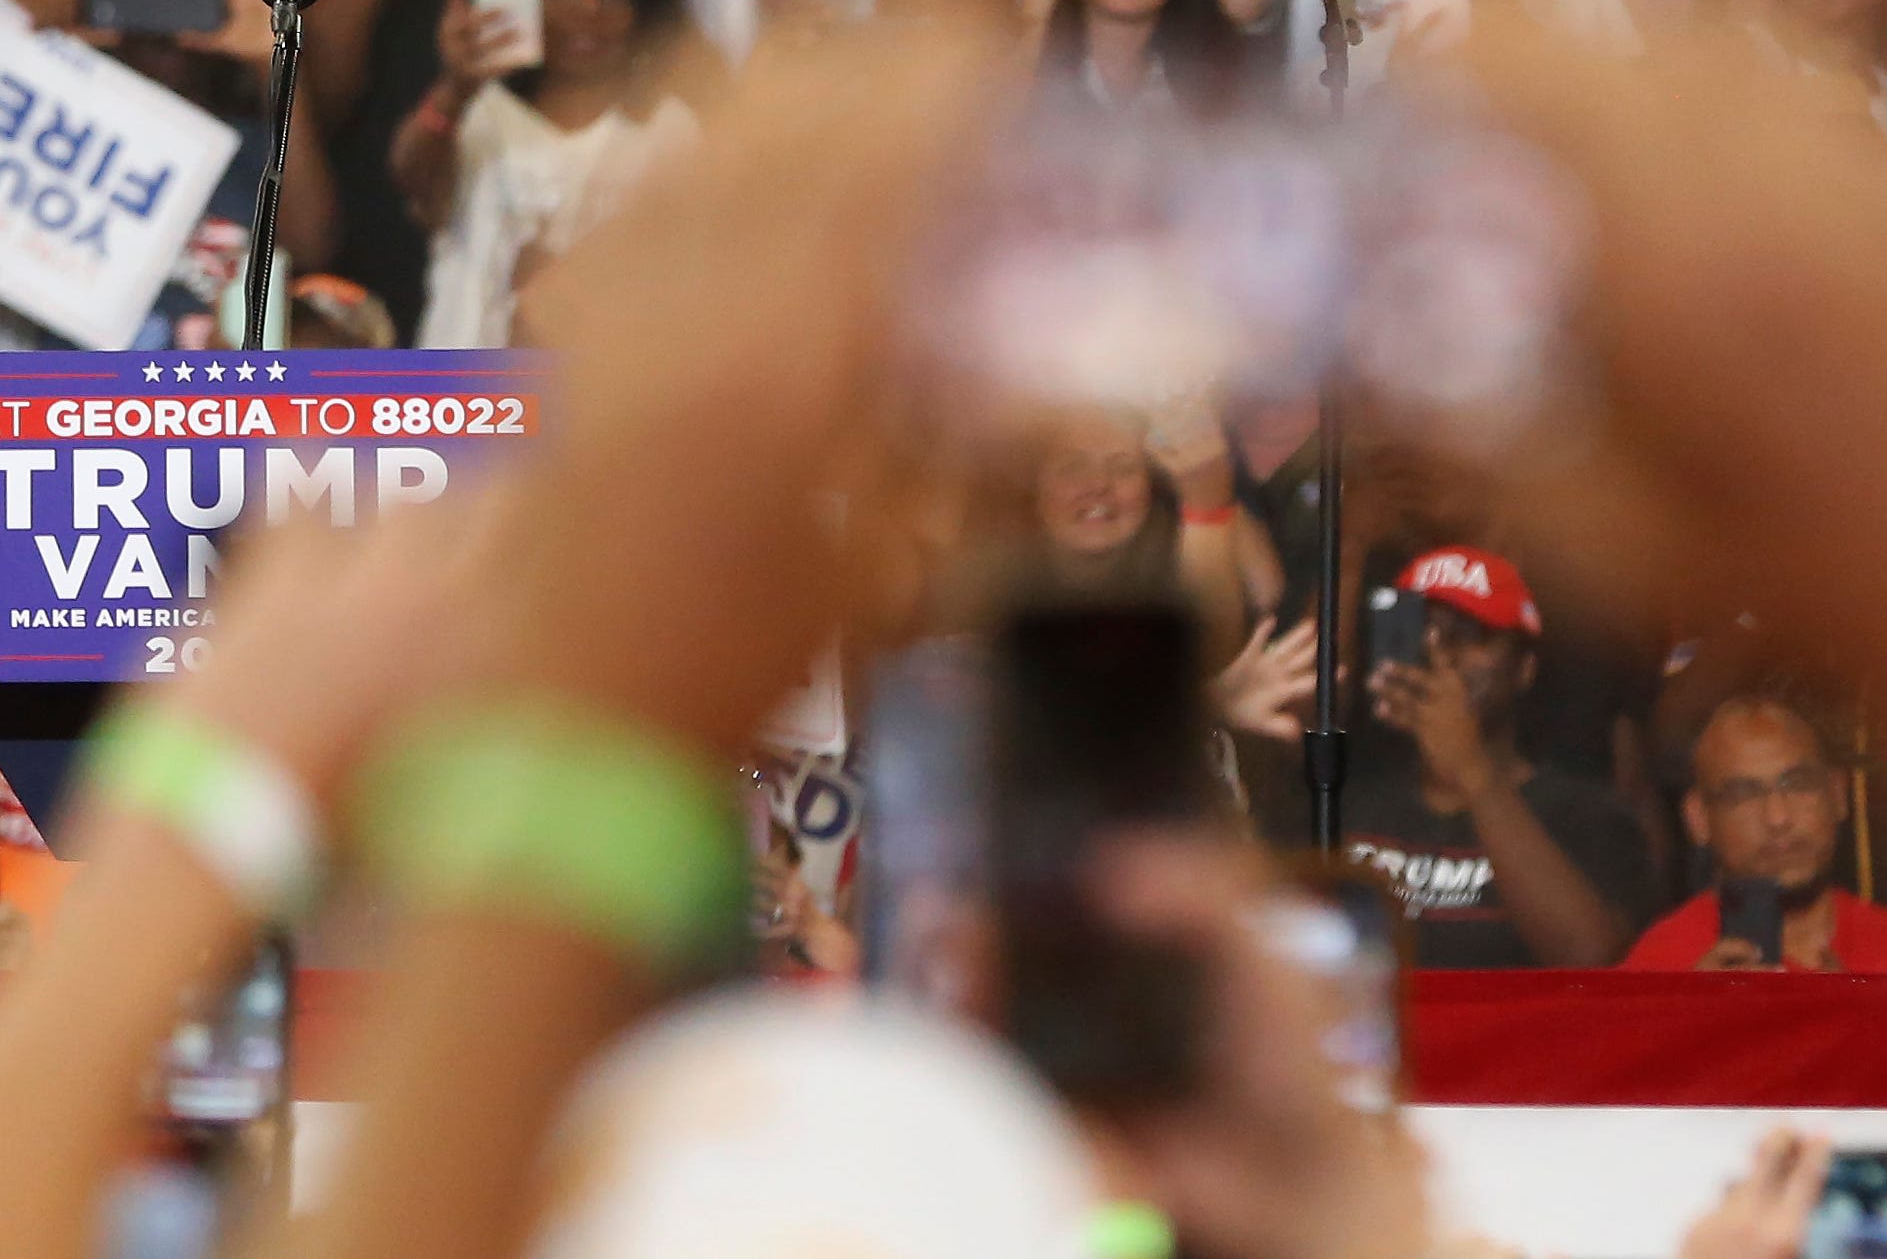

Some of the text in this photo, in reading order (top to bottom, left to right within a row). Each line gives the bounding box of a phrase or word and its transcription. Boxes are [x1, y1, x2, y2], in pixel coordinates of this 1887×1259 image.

[46, 399, 276, 437] GEORGIA
[290, 397, 355, 436] TO
[371, 397, 525, 435] 88022
[11, 608, 86, 628] MAKE
